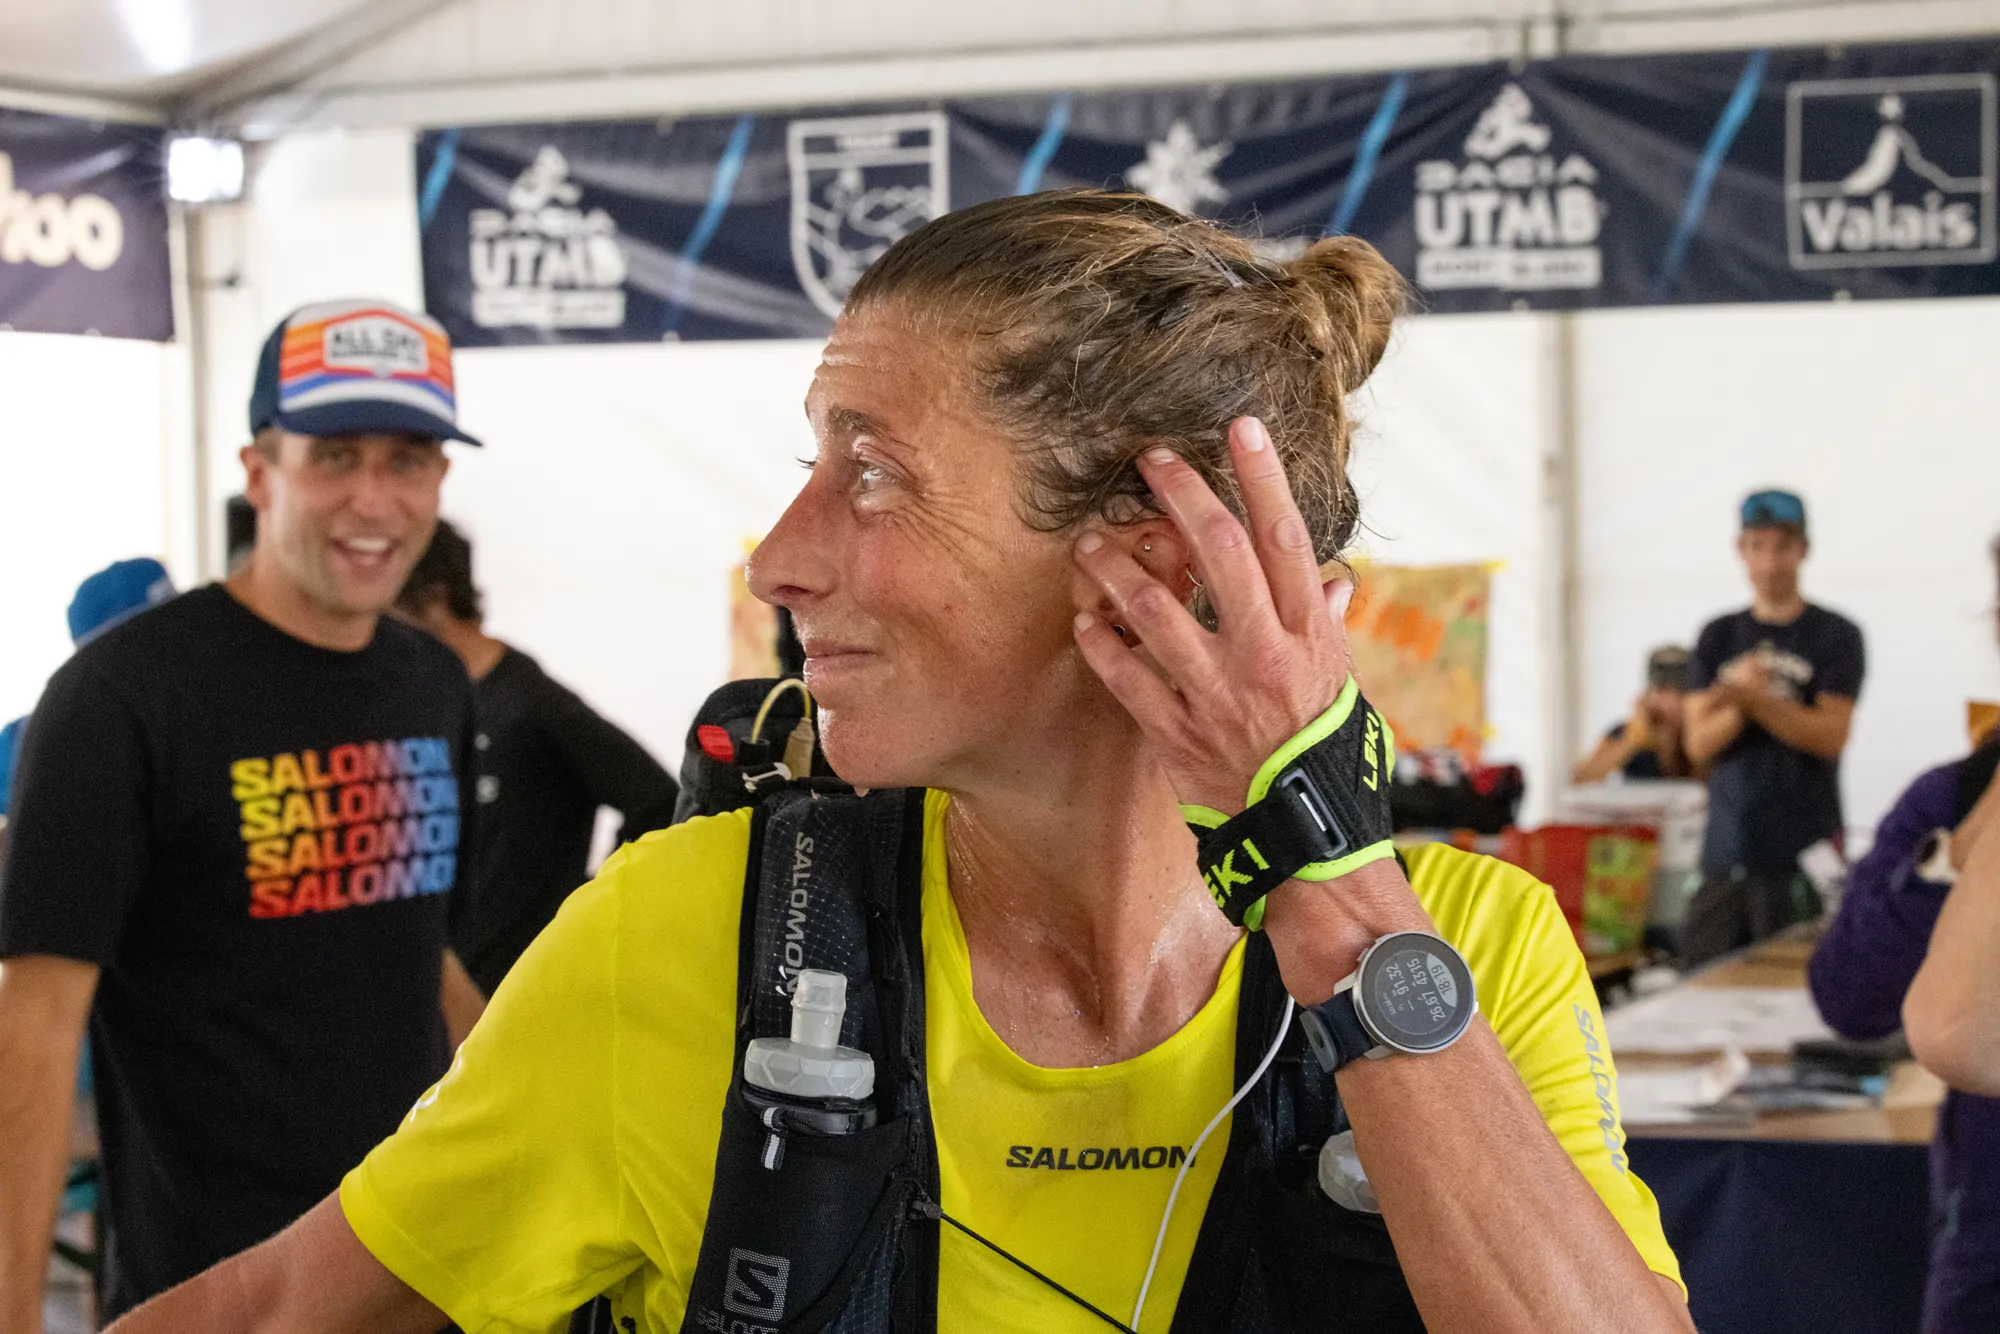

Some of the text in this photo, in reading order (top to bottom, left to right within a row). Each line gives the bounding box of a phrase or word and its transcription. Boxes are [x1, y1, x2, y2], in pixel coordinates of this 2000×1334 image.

[1415, 187, 1599, 247] UTMB
[1802, 190, 1976, 251] Valais
[469, 237, 627, 287] UTMB
[1363, 711, 1381, 792] LEKI
[1386, 963, 1410, 995] 91.32
[1406, 958, 1446, 1021] 26.67 4315
[1431, 964, 1453, 995] 18:19
[1006, 1145, 1196, 1171] SALOMON
